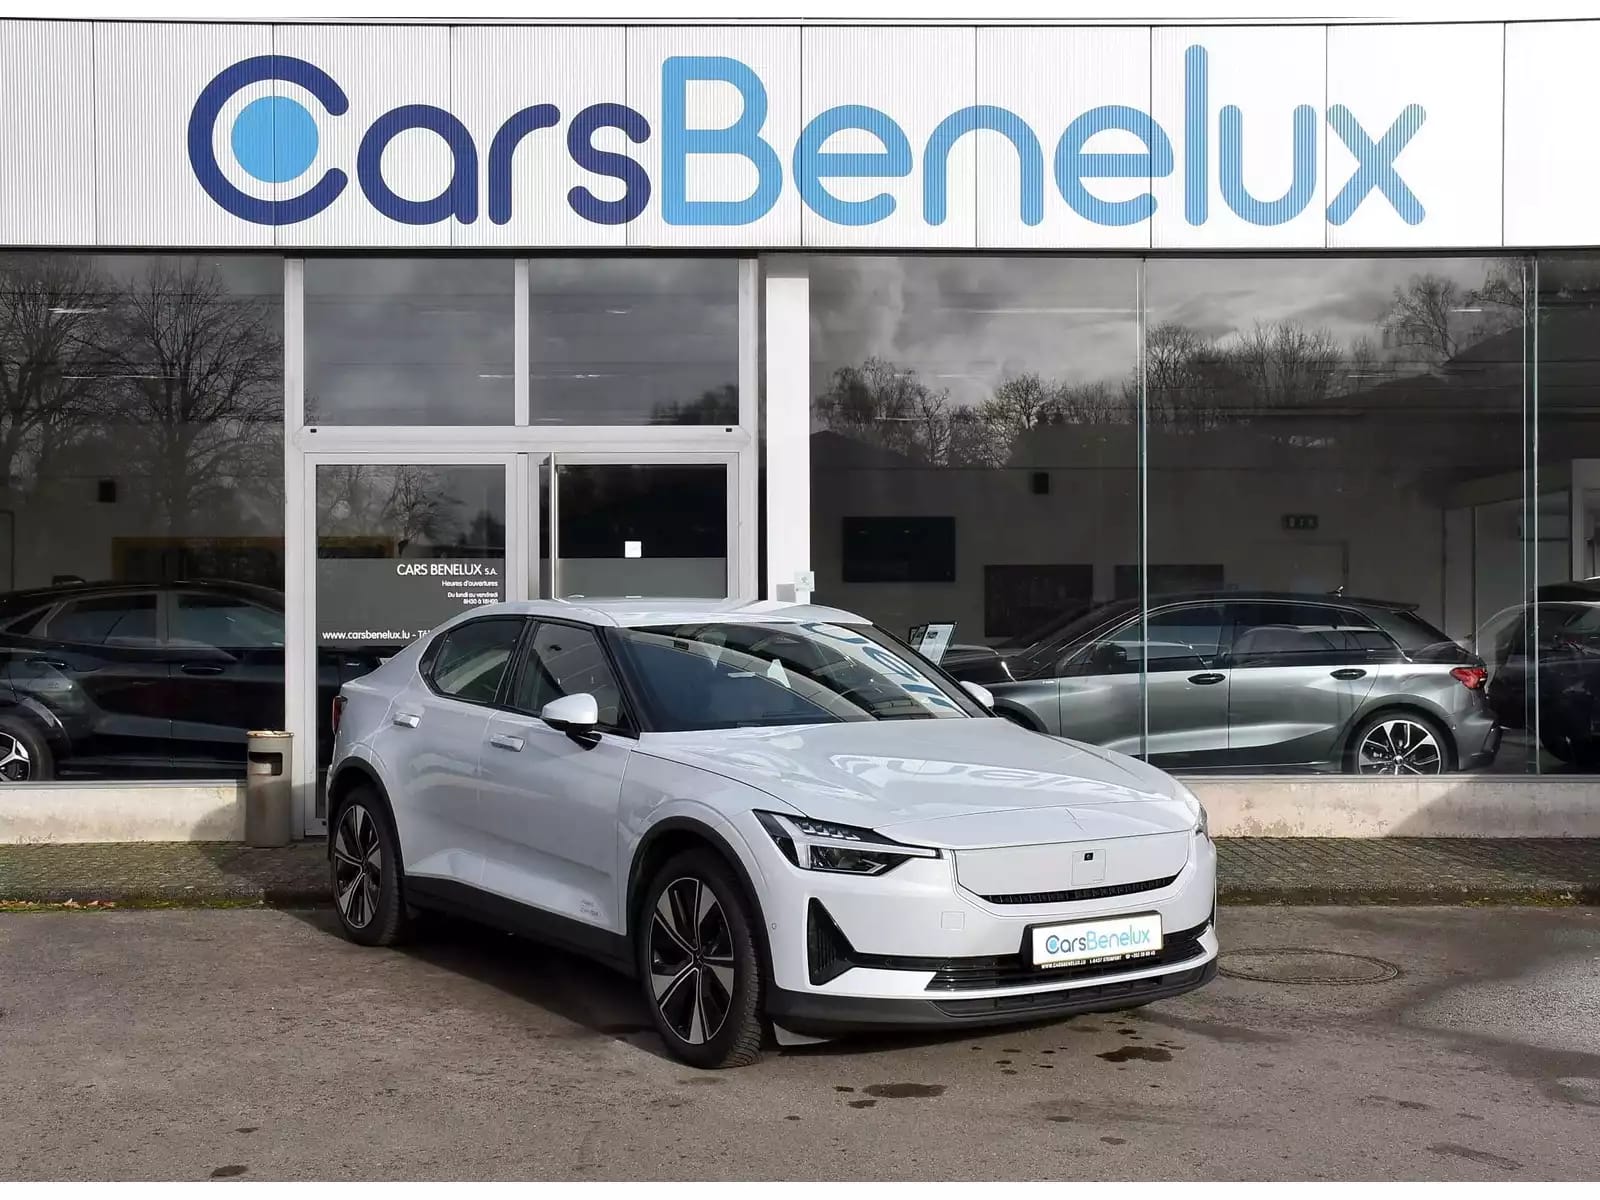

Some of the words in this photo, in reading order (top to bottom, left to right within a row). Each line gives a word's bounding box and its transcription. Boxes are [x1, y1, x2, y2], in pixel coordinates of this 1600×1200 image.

[188, 44, 1426, 225] CarsBenelux
[397, 563, 428, 576] CARS
[430, 563, 482, 576] BENELUX
[484, 568, 498, 576] S.A.
[322, 629, 410, 640] www.carsbenelux.lu
[1045, 924, 1150, 955] CarsBenelux
